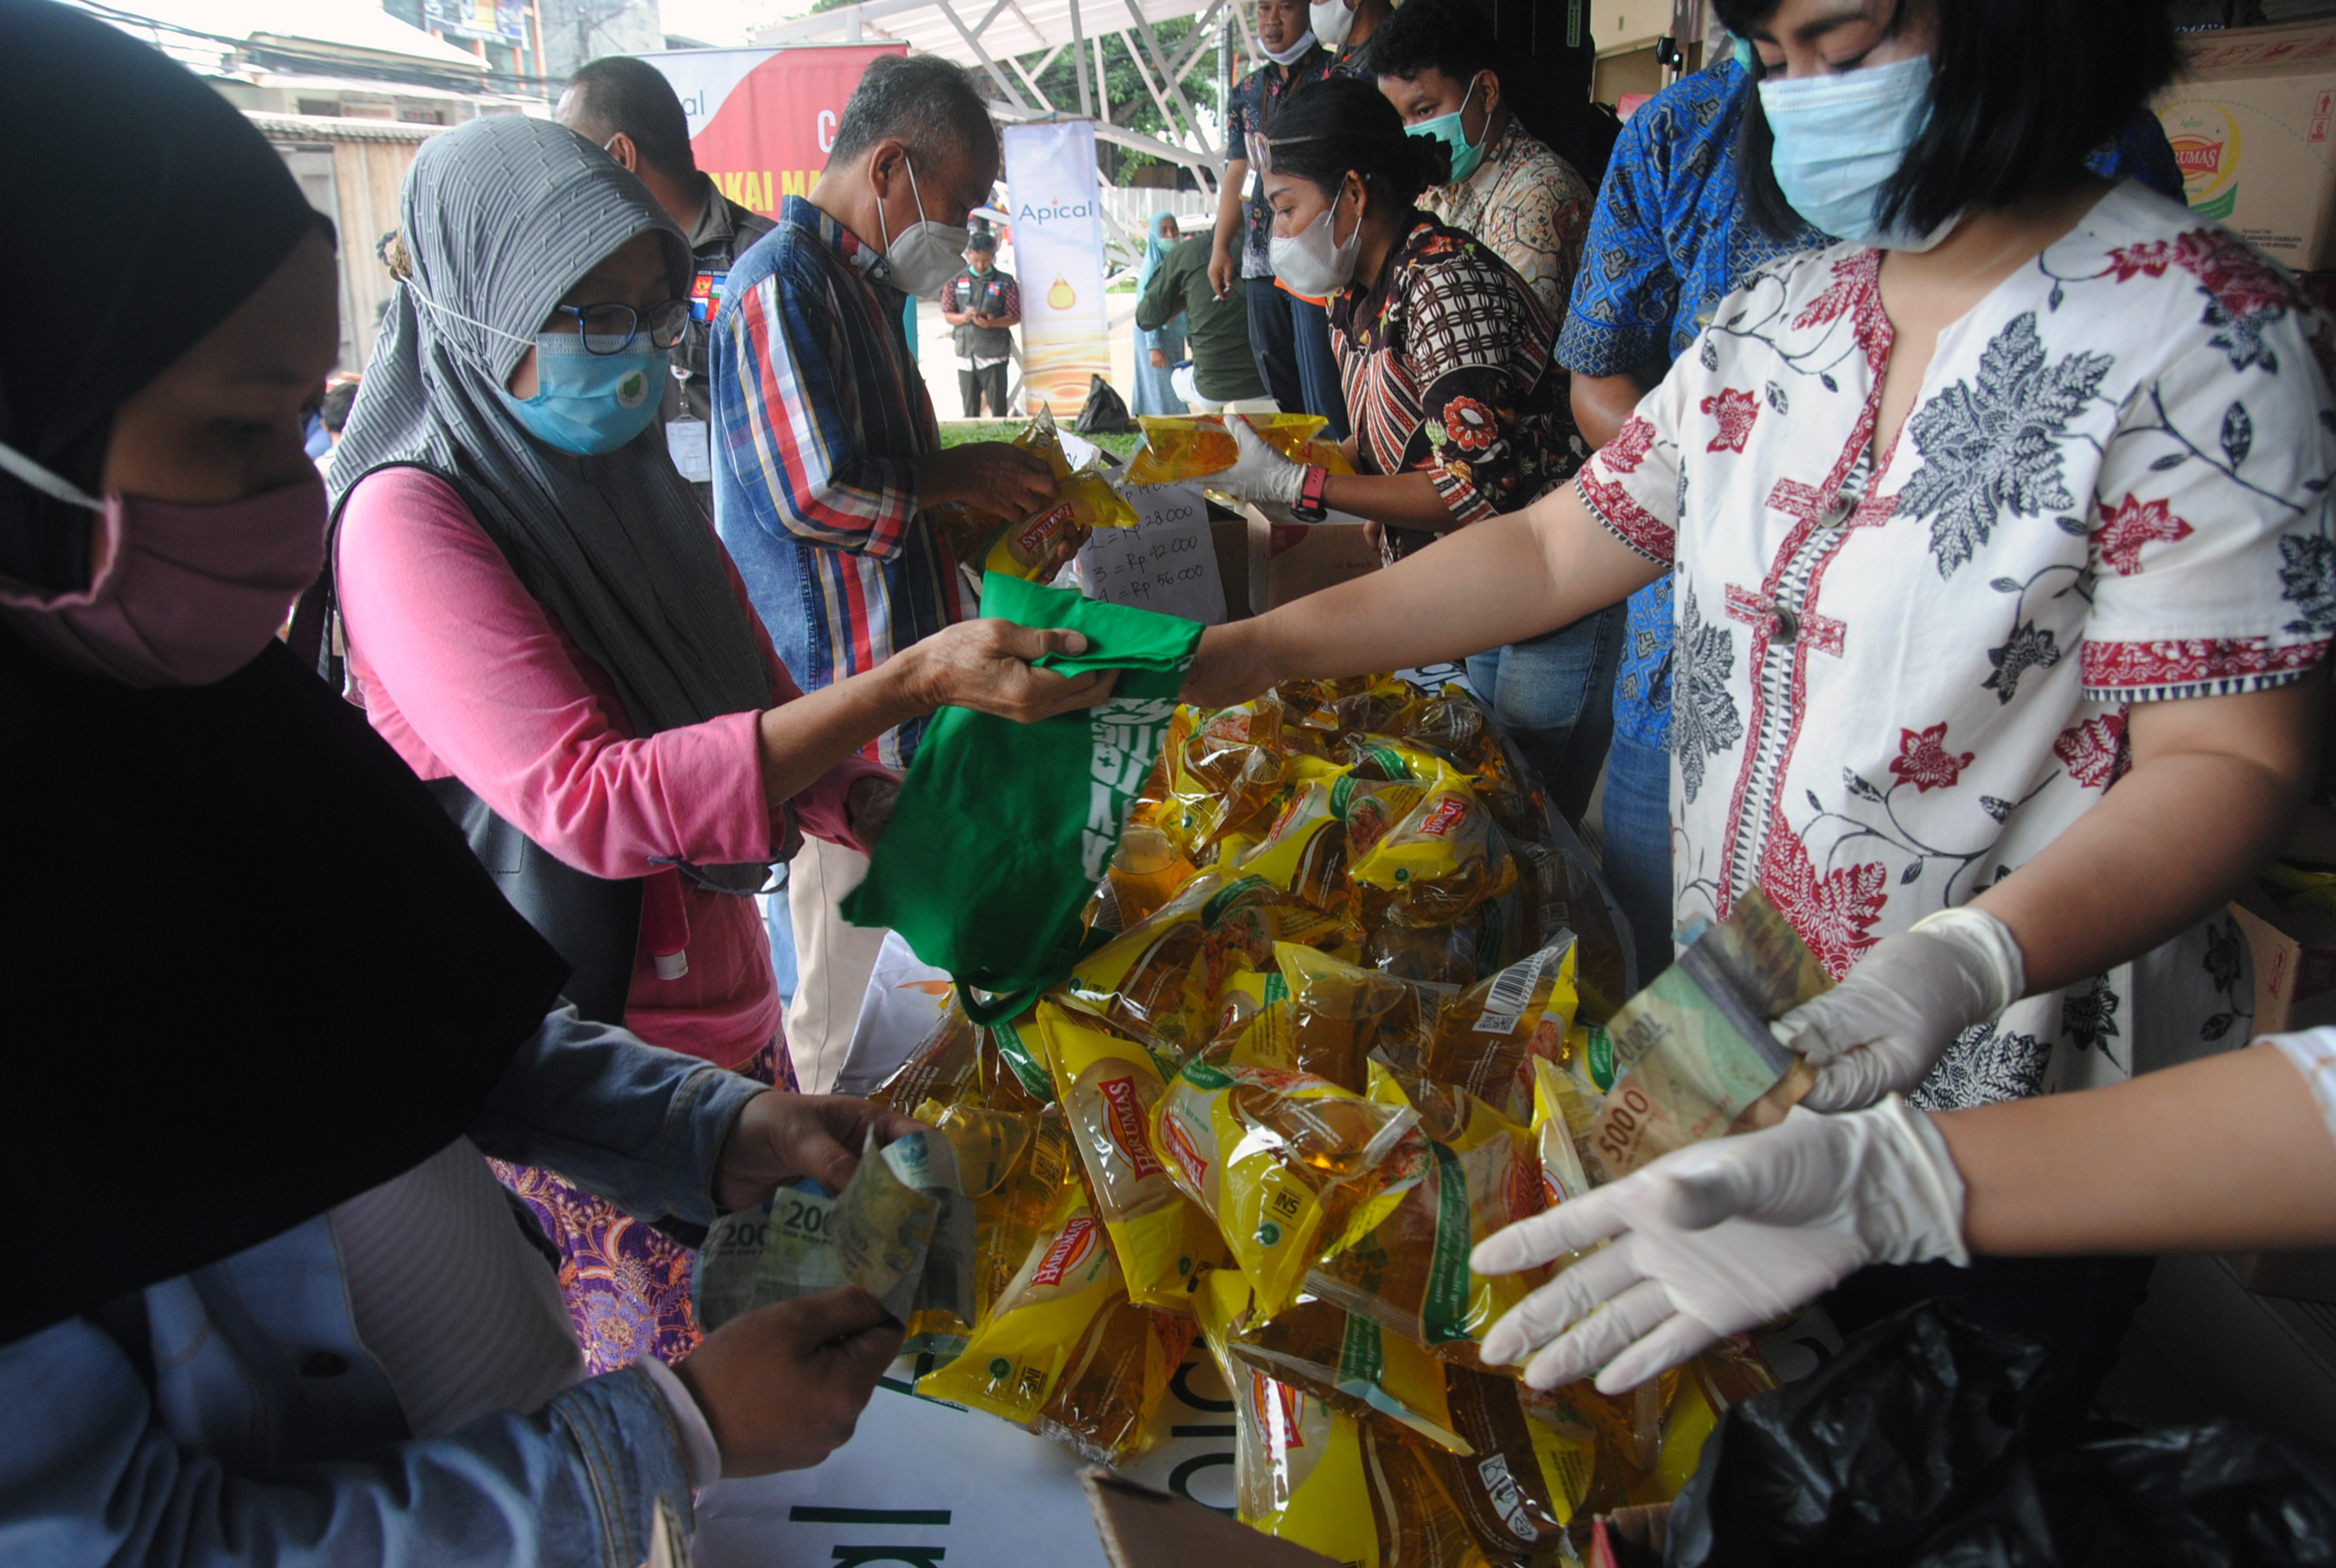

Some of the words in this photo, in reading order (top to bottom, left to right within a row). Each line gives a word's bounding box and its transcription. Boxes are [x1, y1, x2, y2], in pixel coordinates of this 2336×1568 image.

[2175, 150, 2217, 168] RUMAS
[1018, 200, 1093, 225] Apical
[1109, 1082, 1157, 1173] HARUMAS
[1599, 1090, 1649, 1164] 5000
[1275, 1191, 1301, 1215] SNI
[1039, 1219, 1091, 1282] HARUMAS
